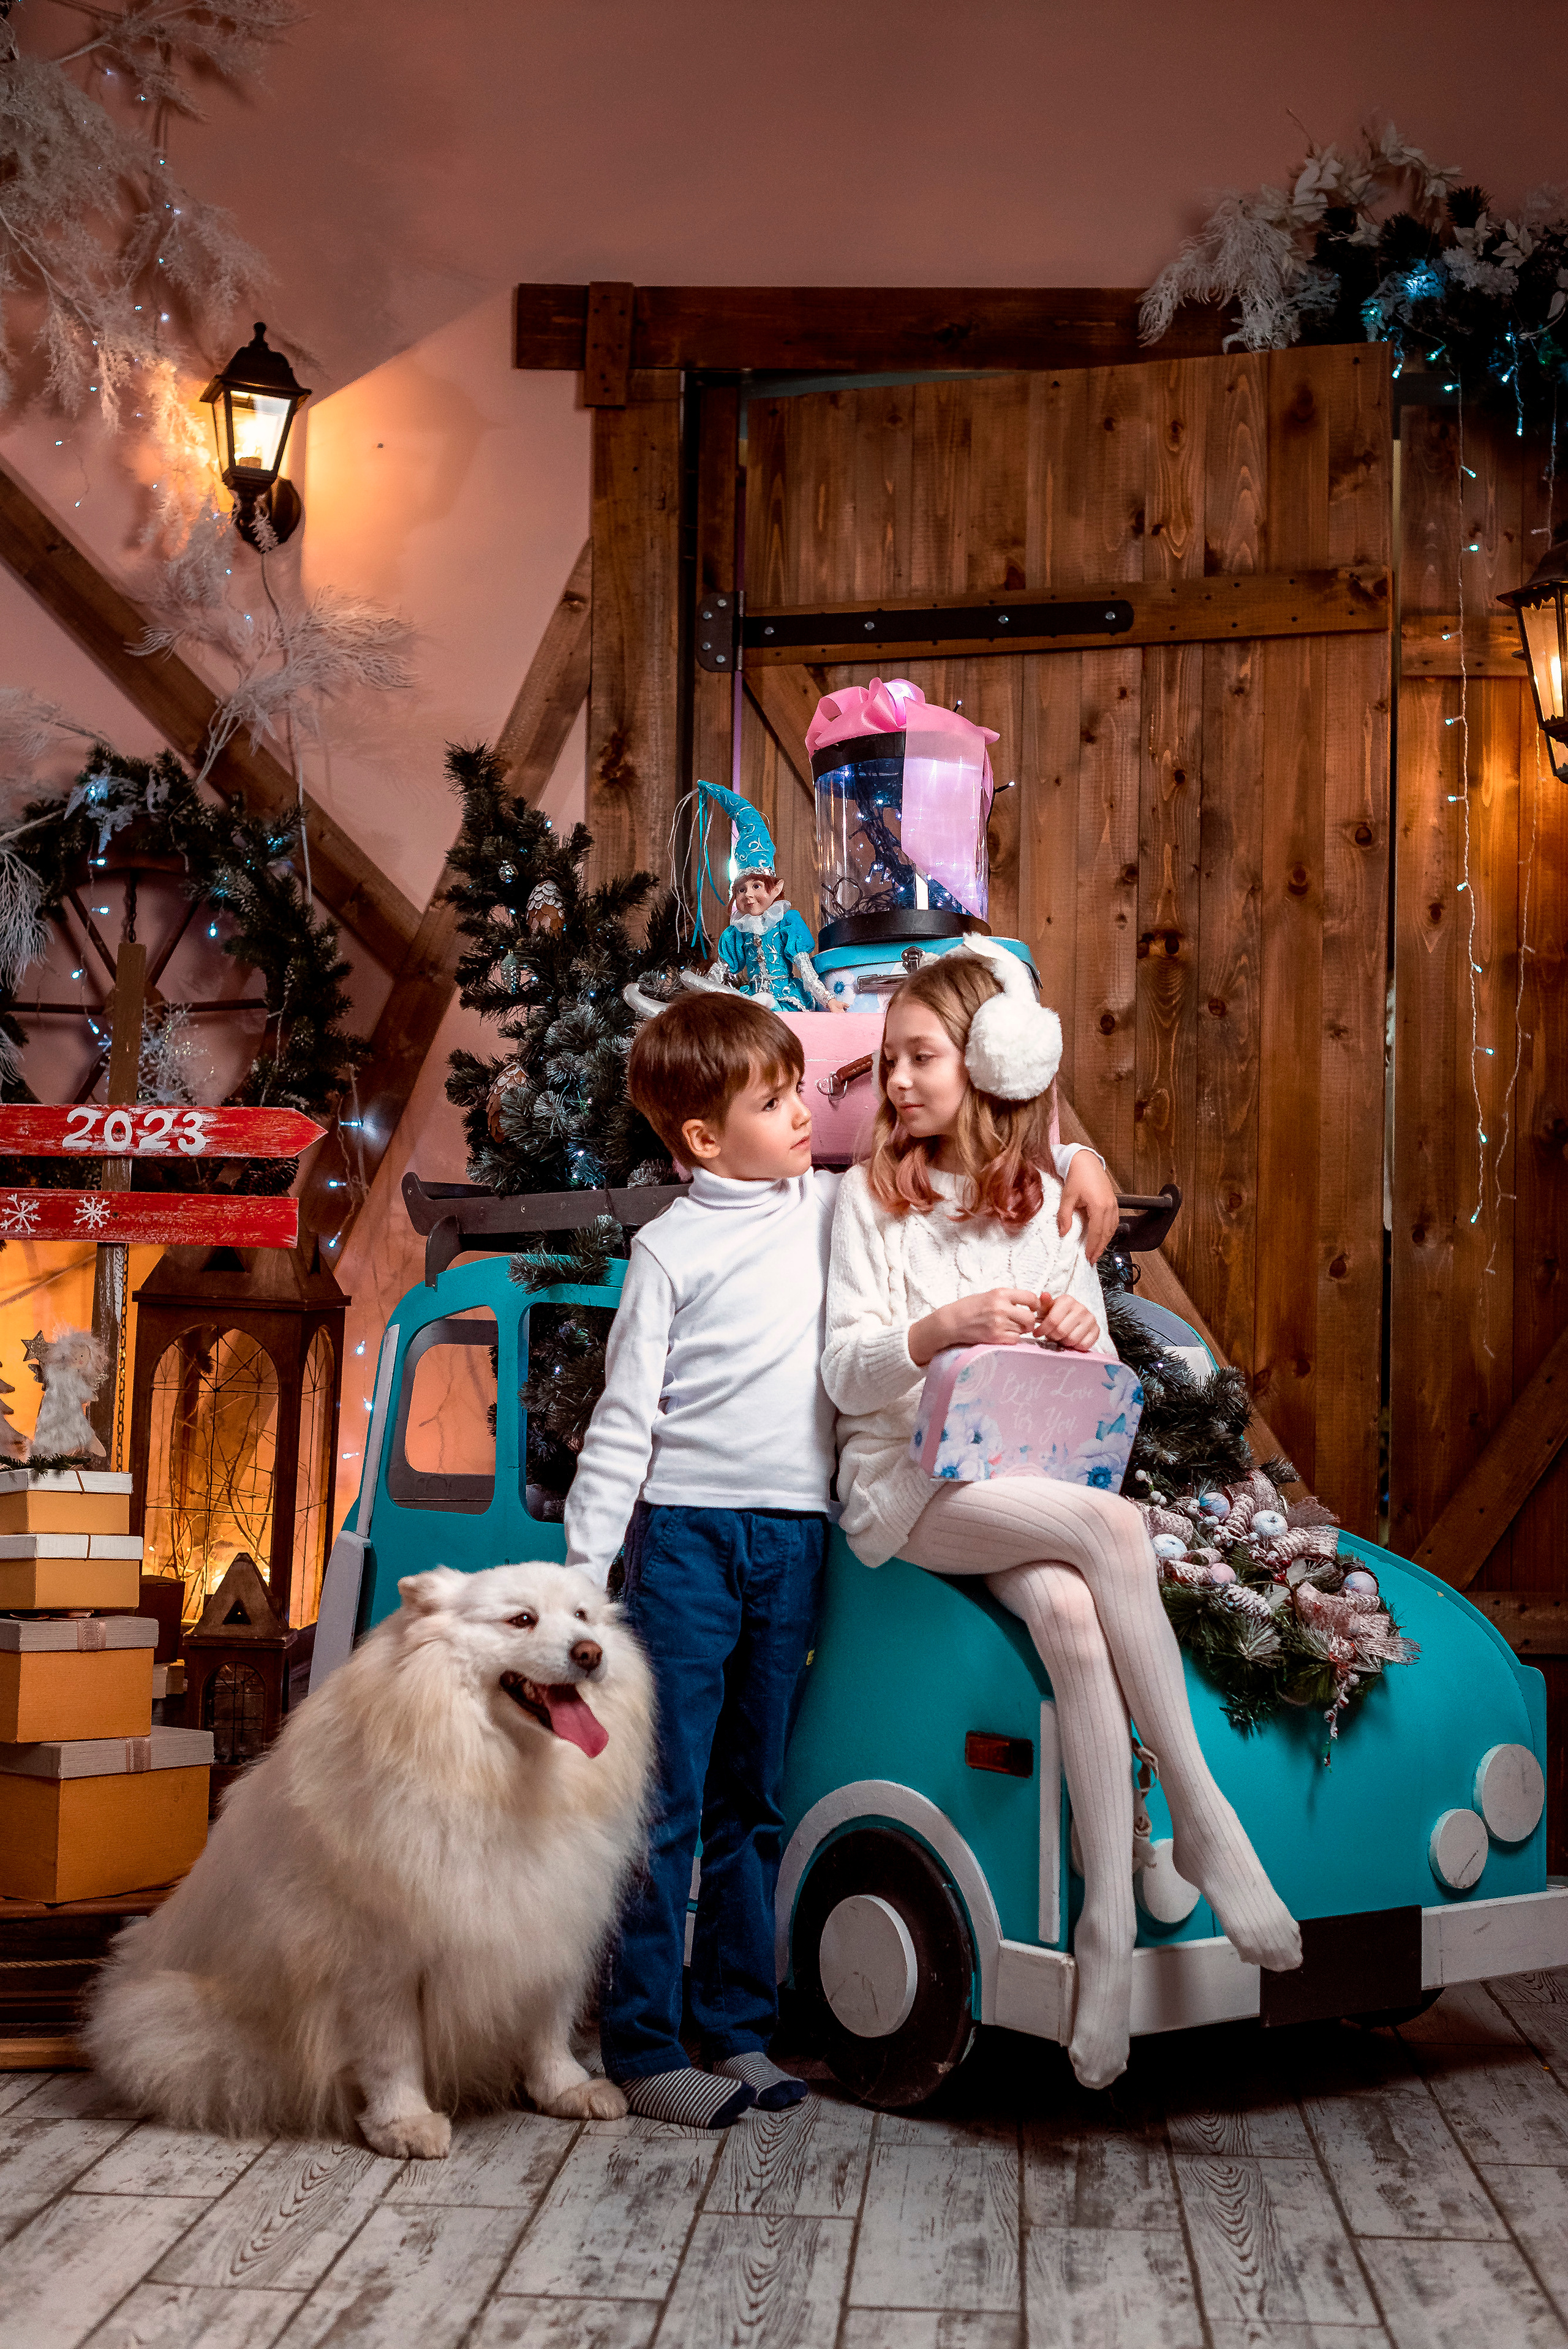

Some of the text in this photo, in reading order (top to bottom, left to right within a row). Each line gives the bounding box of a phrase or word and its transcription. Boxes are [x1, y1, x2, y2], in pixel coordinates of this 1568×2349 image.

[62, 1107, 207, 1155] 2023
[1049, 1366, 1095, 1402] Love
[1039, 1407, 1079, 1444] You
